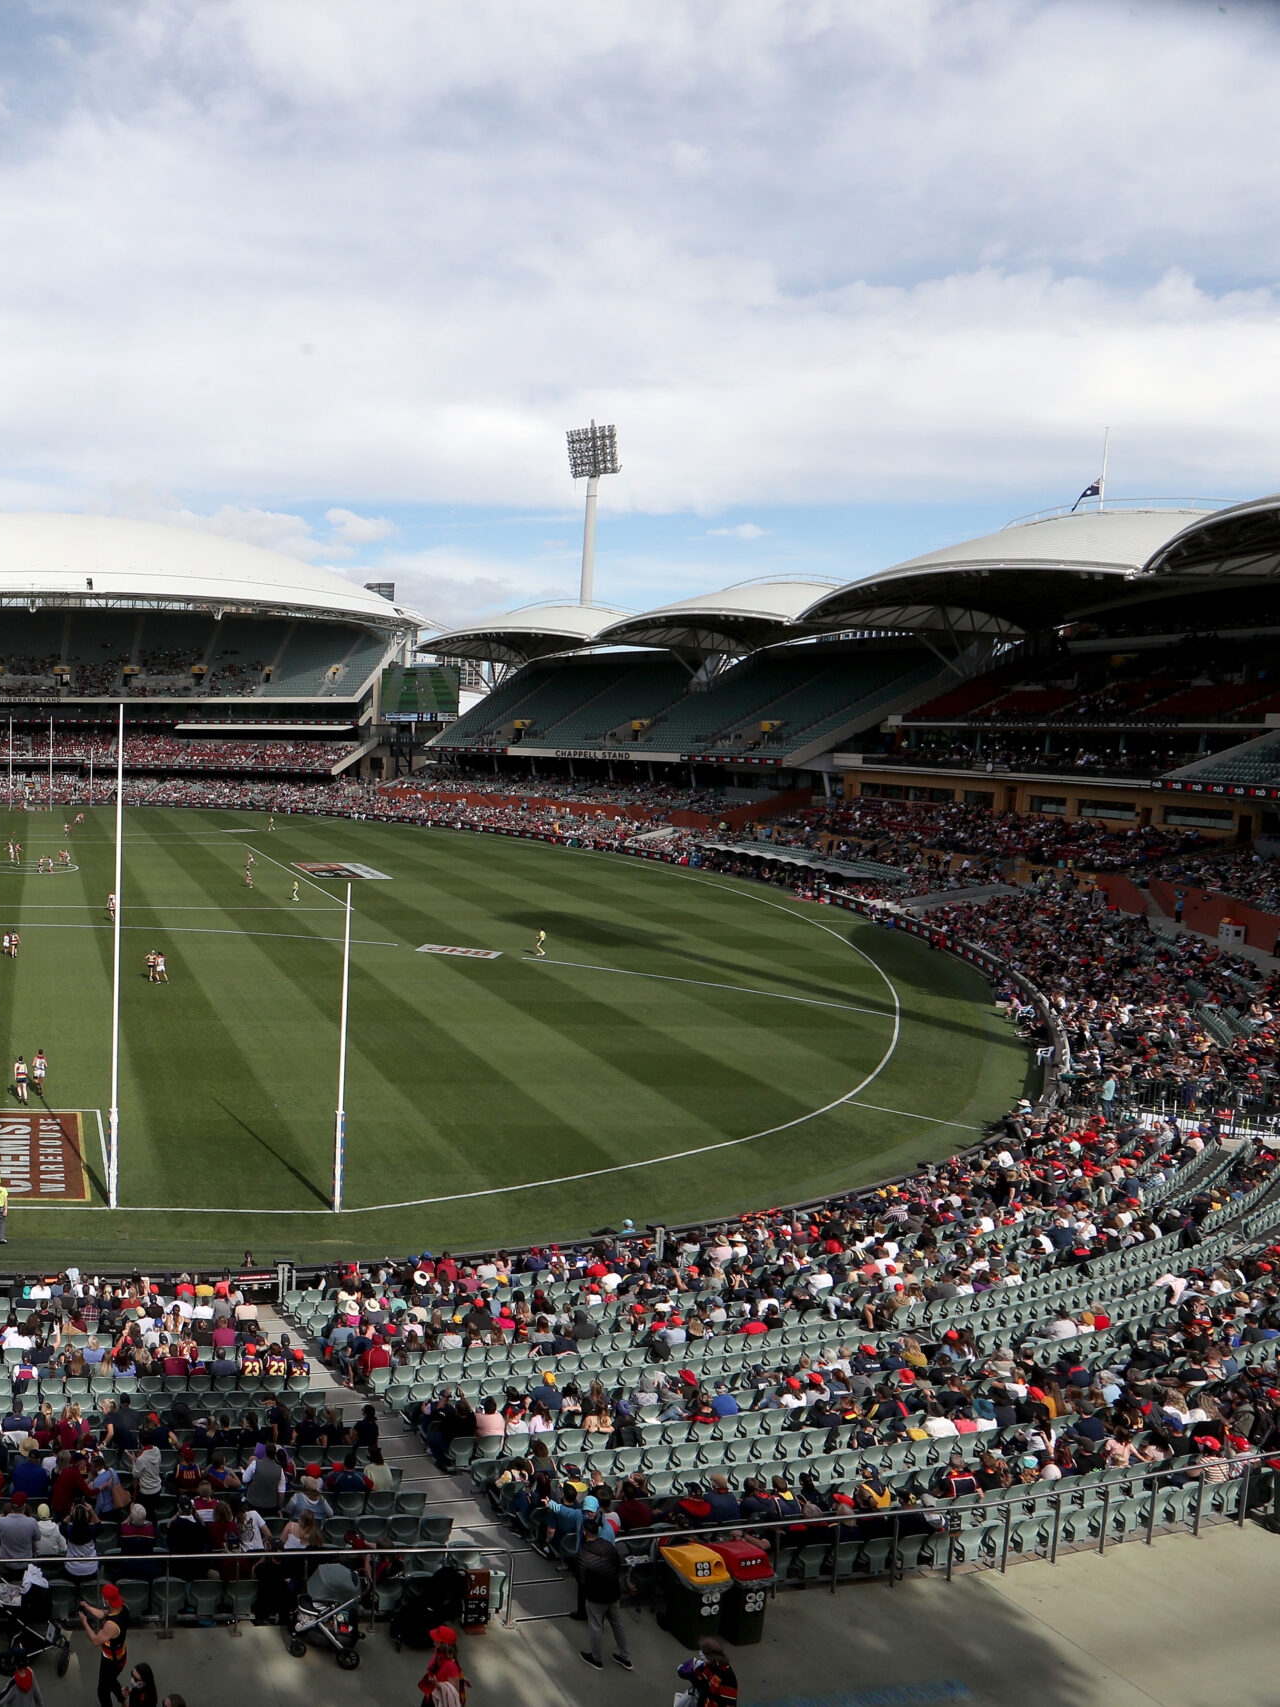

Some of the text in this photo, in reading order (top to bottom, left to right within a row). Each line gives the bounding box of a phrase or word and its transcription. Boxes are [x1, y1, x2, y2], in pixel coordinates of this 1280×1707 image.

[554, 750, 630, 760] CHAPPELL STAND
[38, 1118, 66, 1193] WAREHOUSE
[244, 1361, 260, 1376] 23
[269, 1361, 285, 1376] 23
